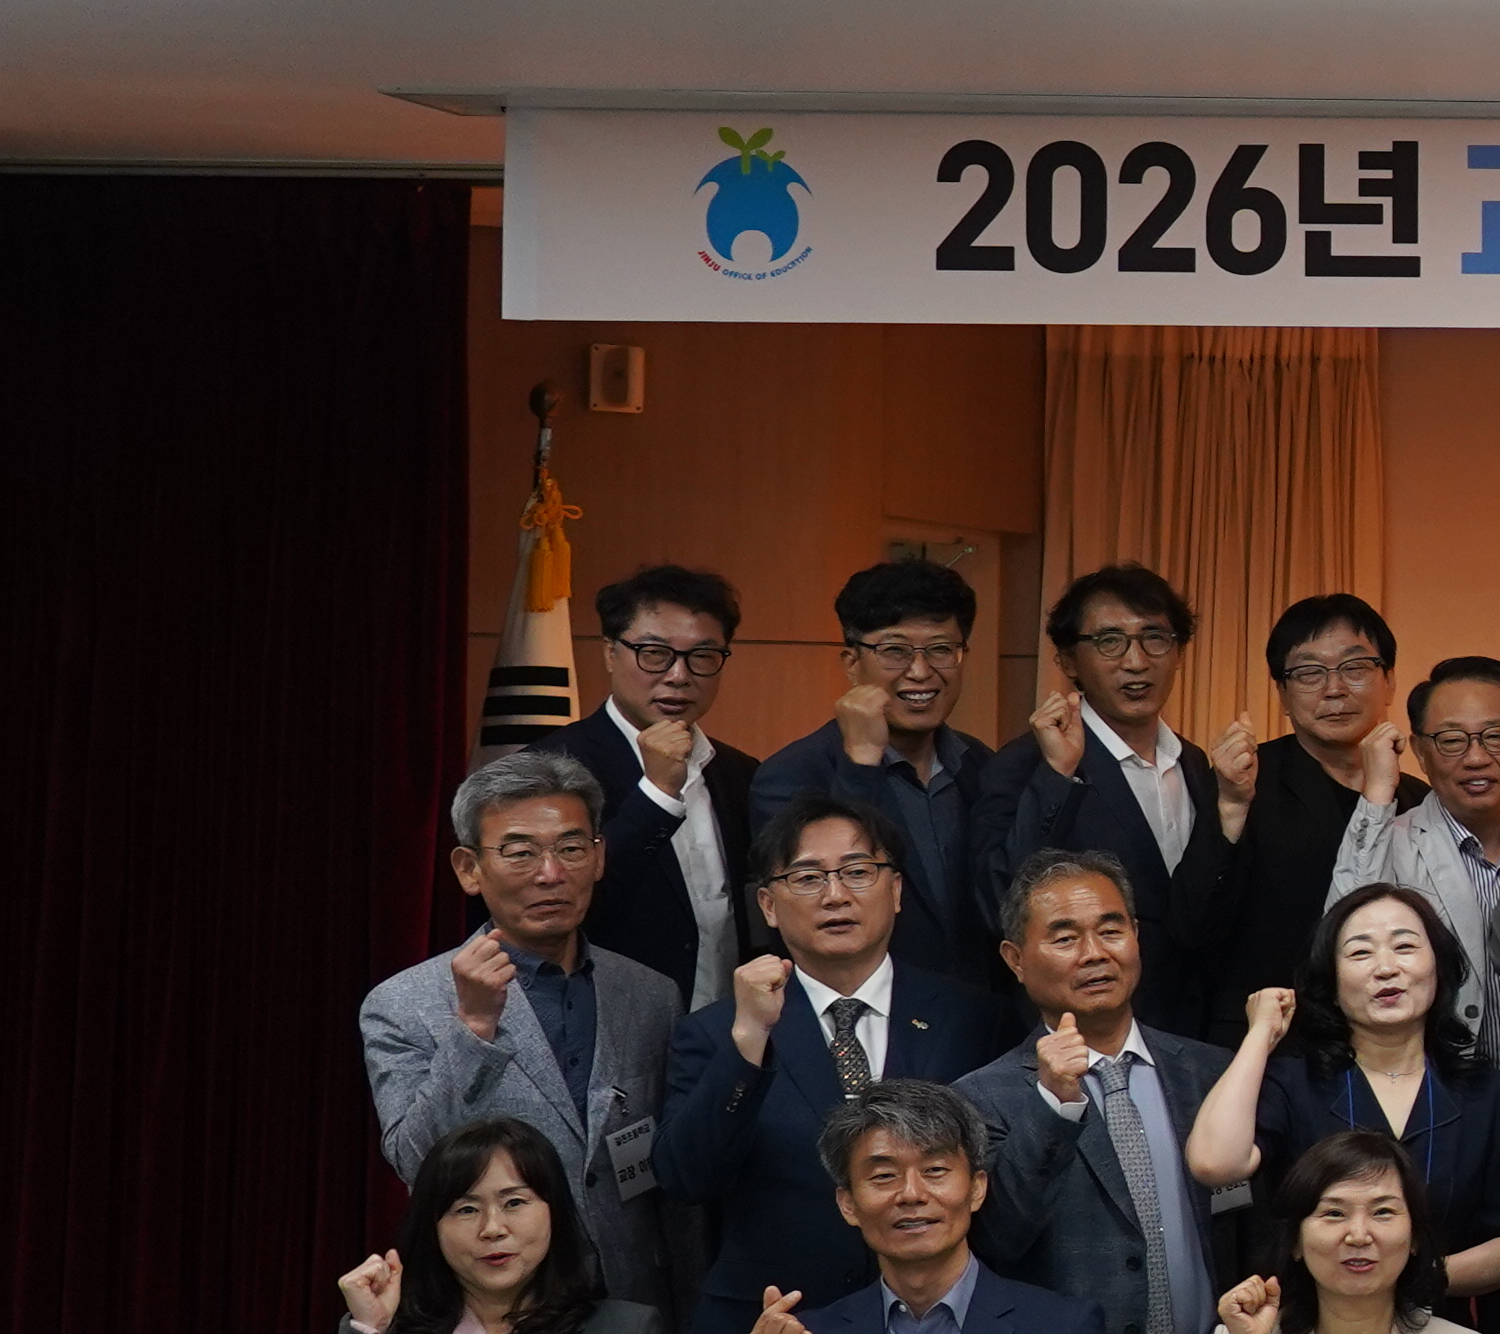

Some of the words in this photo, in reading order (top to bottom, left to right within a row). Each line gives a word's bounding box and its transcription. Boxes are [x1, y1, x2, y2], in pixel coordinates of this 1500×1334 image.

[936, 139, 1420, 277] 2026년
[698, 250, 720, 271] JINJU
[722, 268, 752, 280] OFFICE
[755, 272, 767, 280] OF
[770, 246, 813, 277] EDUCATION
[617, 1166, 637, 1184] 교장
